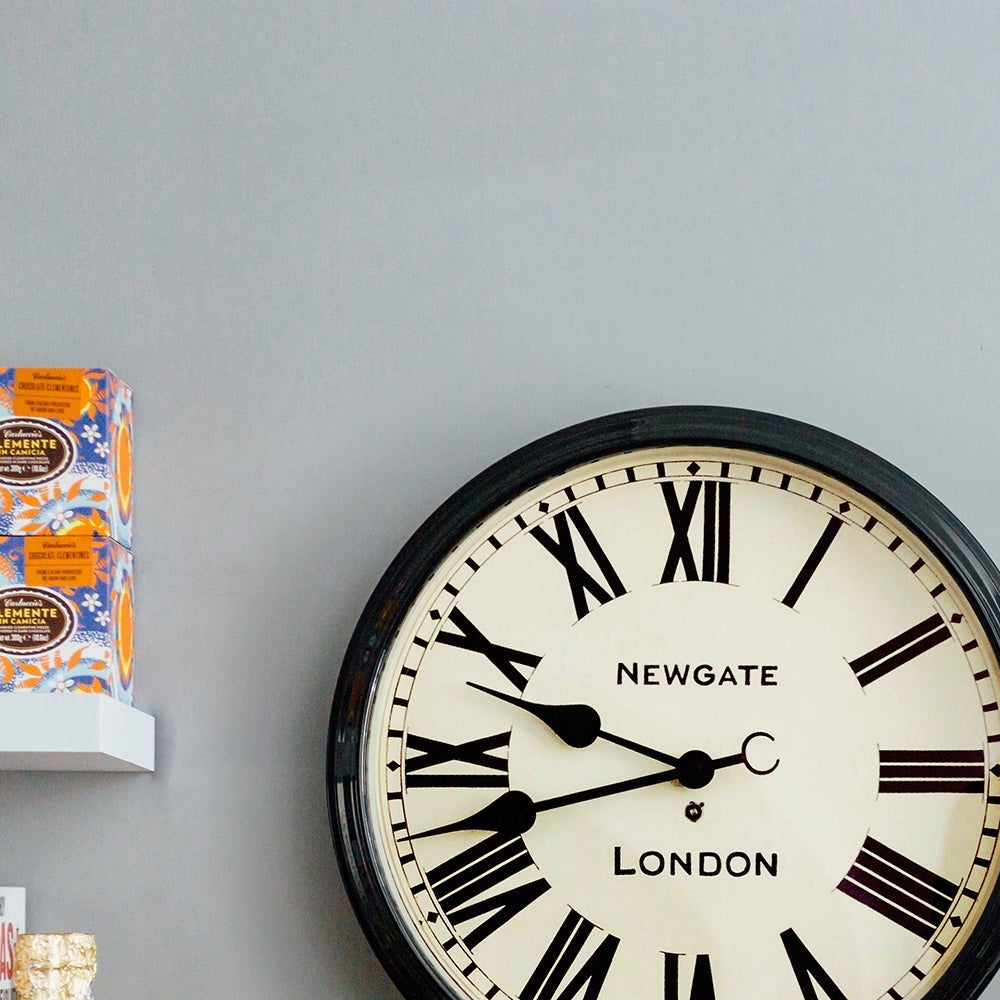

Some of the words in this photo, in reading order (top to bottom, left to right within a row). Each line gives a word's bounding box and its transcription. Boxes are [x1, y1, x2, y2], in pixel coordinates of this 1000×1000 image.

[528, 501, 627, 626] XI
[655, 480, 738, 586] XII
[434, 605, 543, 692] X
[616, 662, 778, 687] NEWGATE
[612, 846, 778, 877] LONDON
